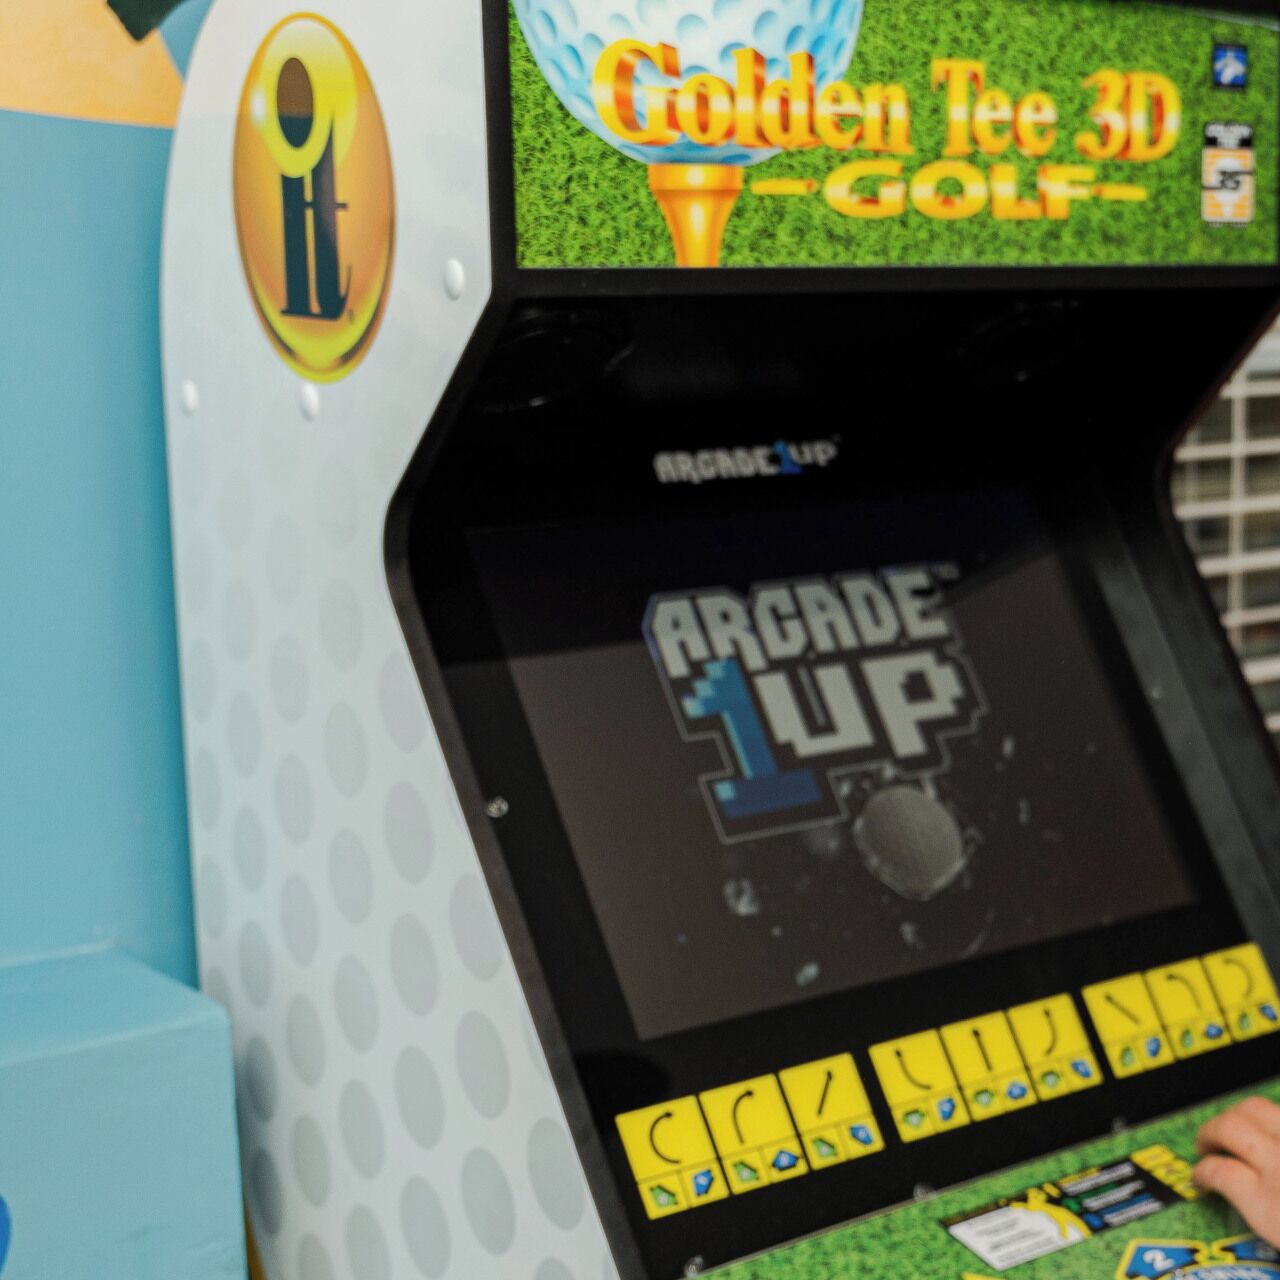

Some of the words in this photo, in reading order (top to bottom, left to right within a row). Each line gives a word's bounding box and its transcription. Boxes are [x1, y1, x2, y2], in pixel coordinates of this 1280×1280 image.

[592, 38, 912, 154] Golden
[931, 59, 1058, 158] Tee
[1075, 69, 1182, 161] 3D
[823, 160, 1097, 220] GOLF
[652, 567, 951, 679] ARCADE
[682, 650, 966, 818] 1UP
[1143, 1249, 1175, 1271] 2
